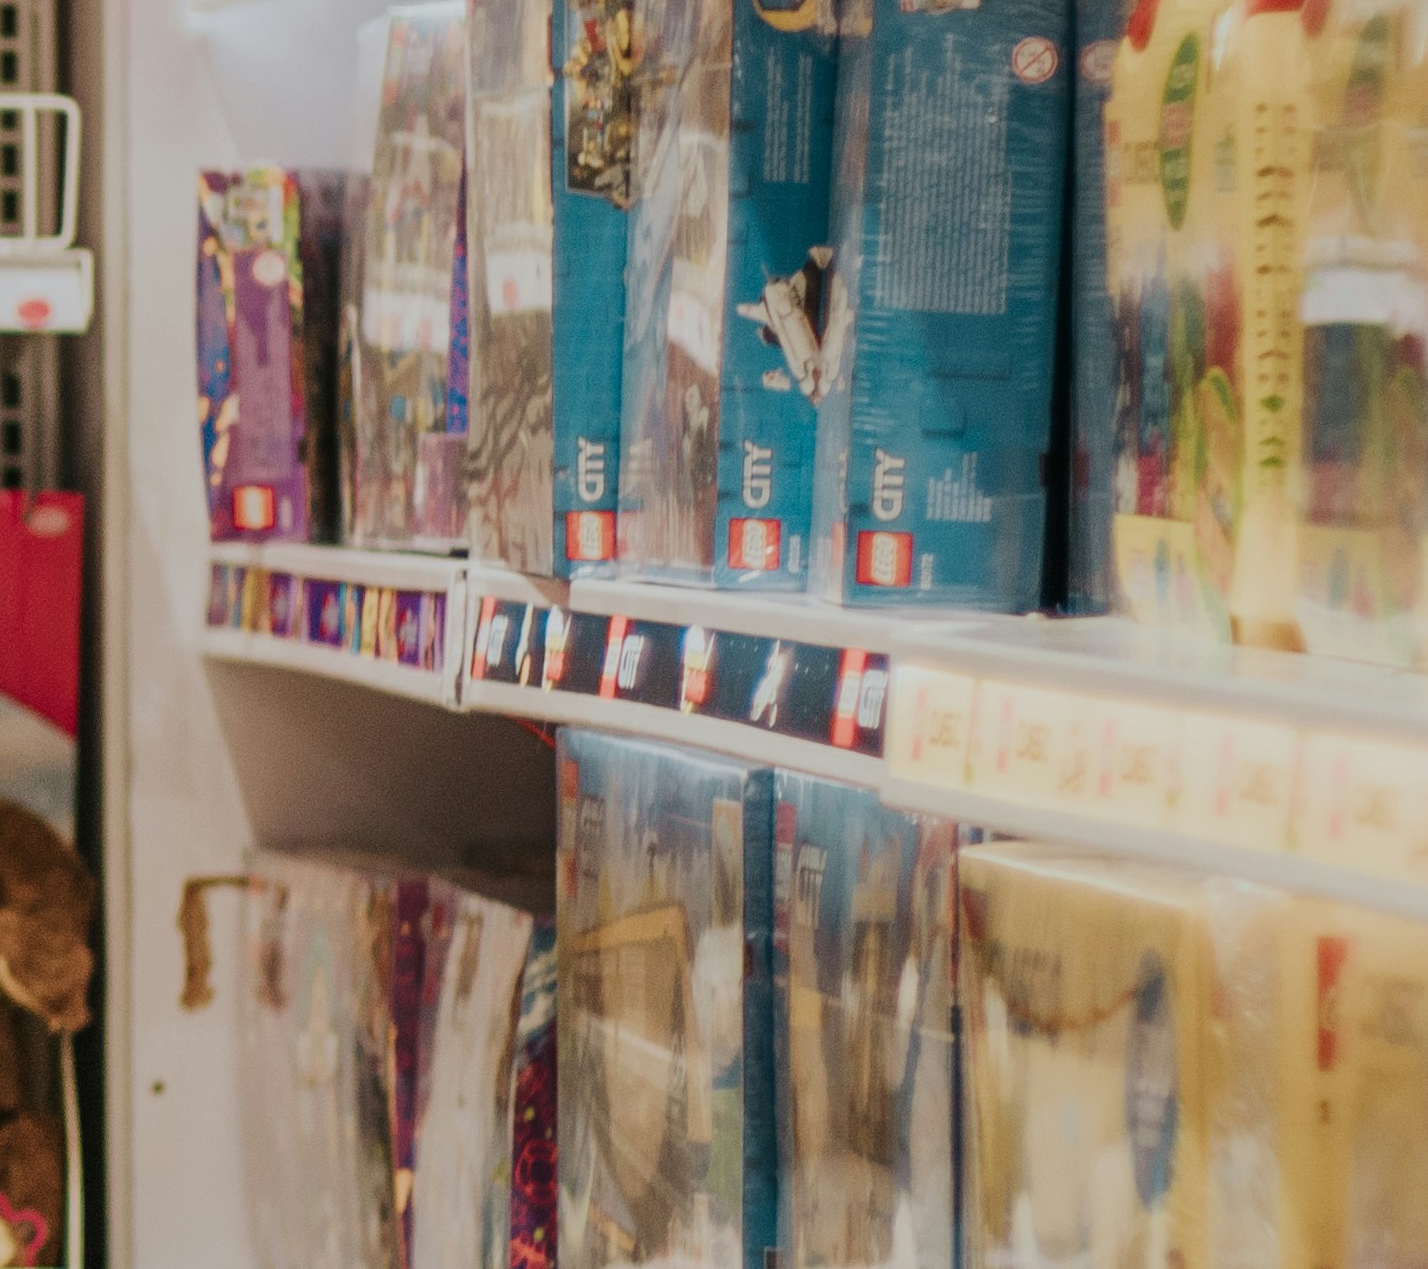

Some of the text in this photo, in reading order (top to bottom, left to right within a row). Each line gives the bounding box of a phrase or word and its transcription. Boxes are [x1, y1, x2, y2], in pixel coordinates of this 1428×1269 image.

[578, 436, 605, 504] CITY
[742, 439, 773, 509] CITY
[872, 447, 906, 522] CITY
[742, 520, 765, 568] LEGO
[873, 531, 897, 585] LEGO
